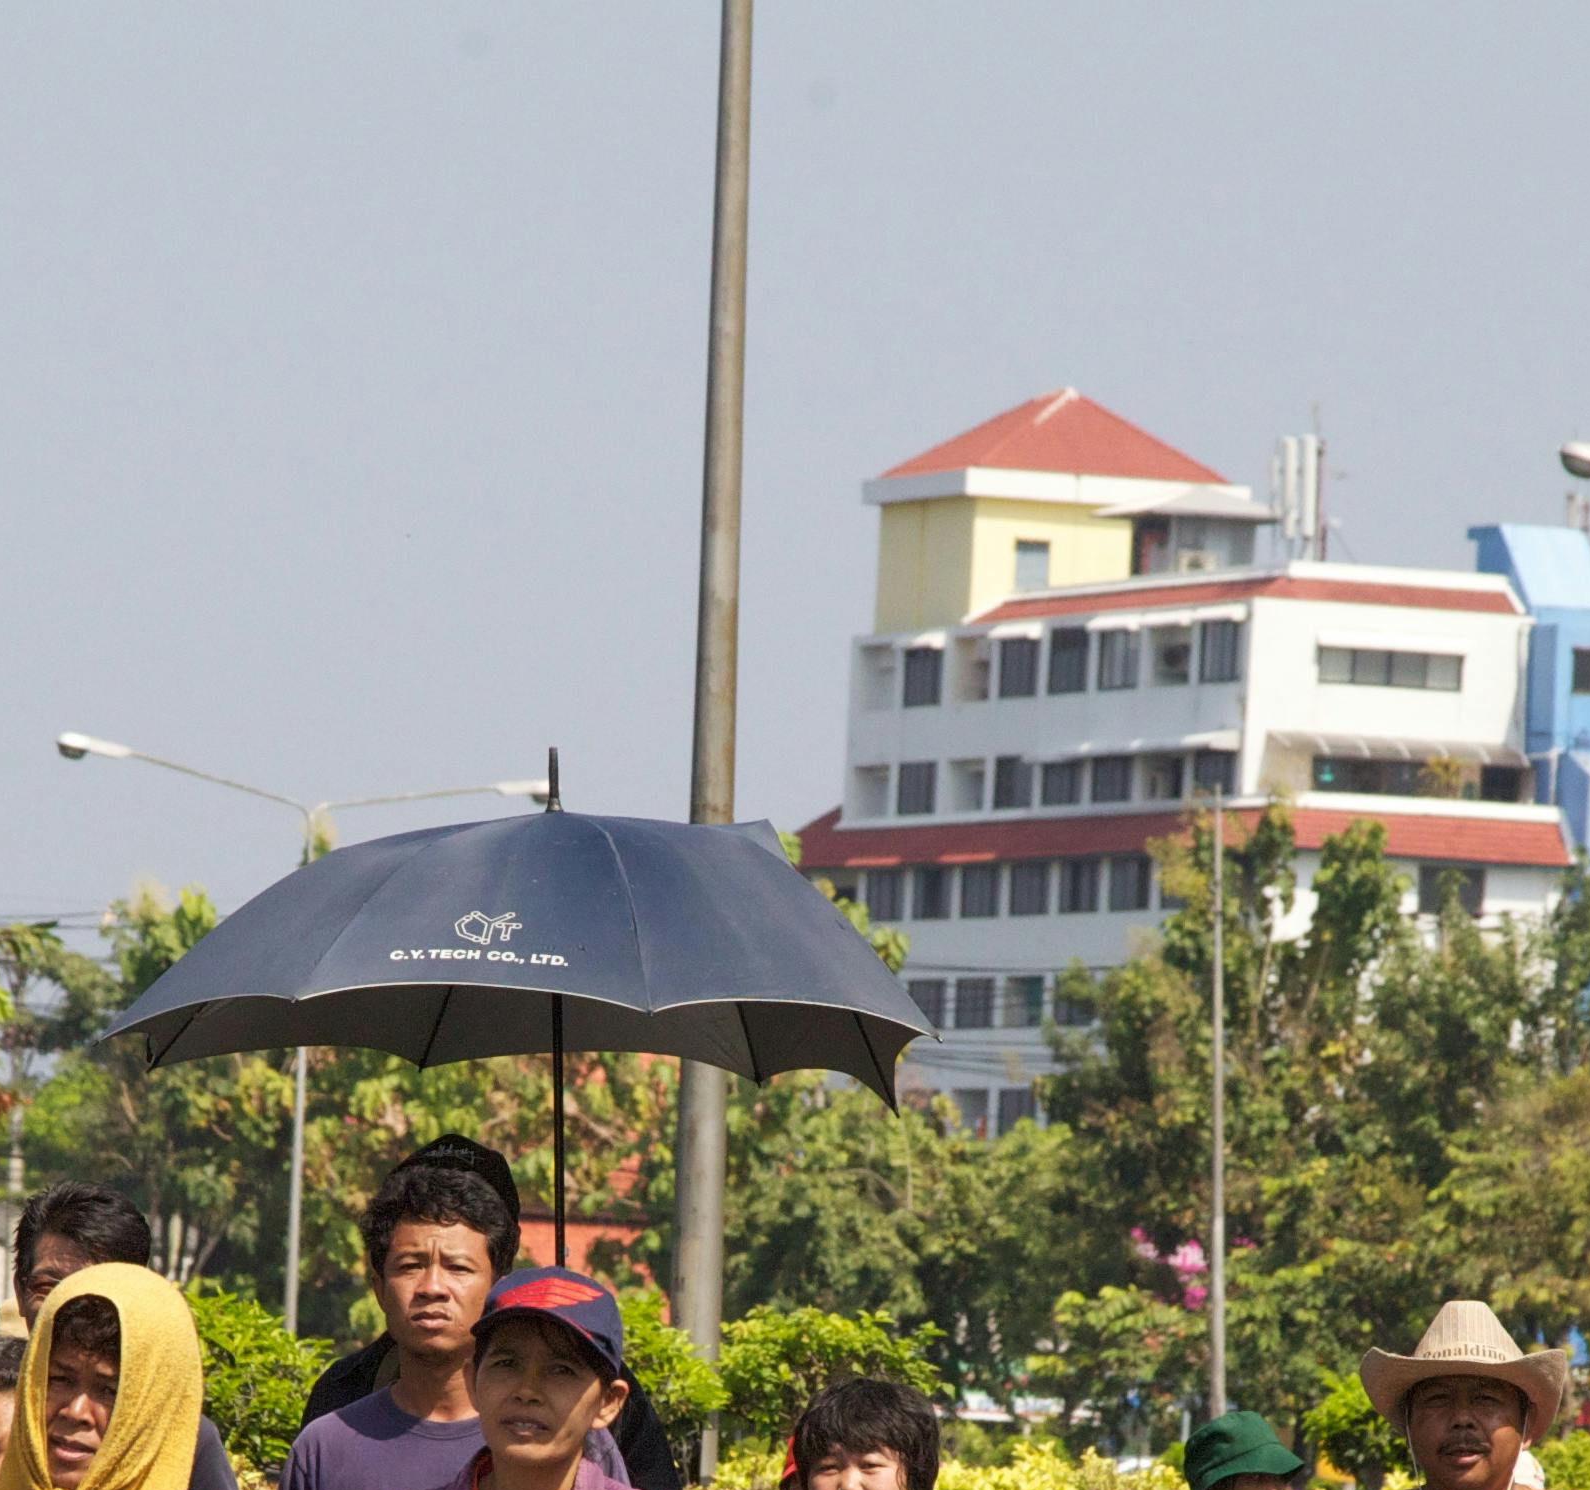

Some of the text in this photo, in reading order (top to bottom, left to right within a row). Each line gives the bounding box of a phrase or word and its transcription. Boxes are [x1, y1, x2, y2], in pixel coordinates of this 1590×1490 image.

[429, 949, 481, 961] TECH
[486, 951, 525, 965] CO.,
[530, 954, 569, 967] LTD.
